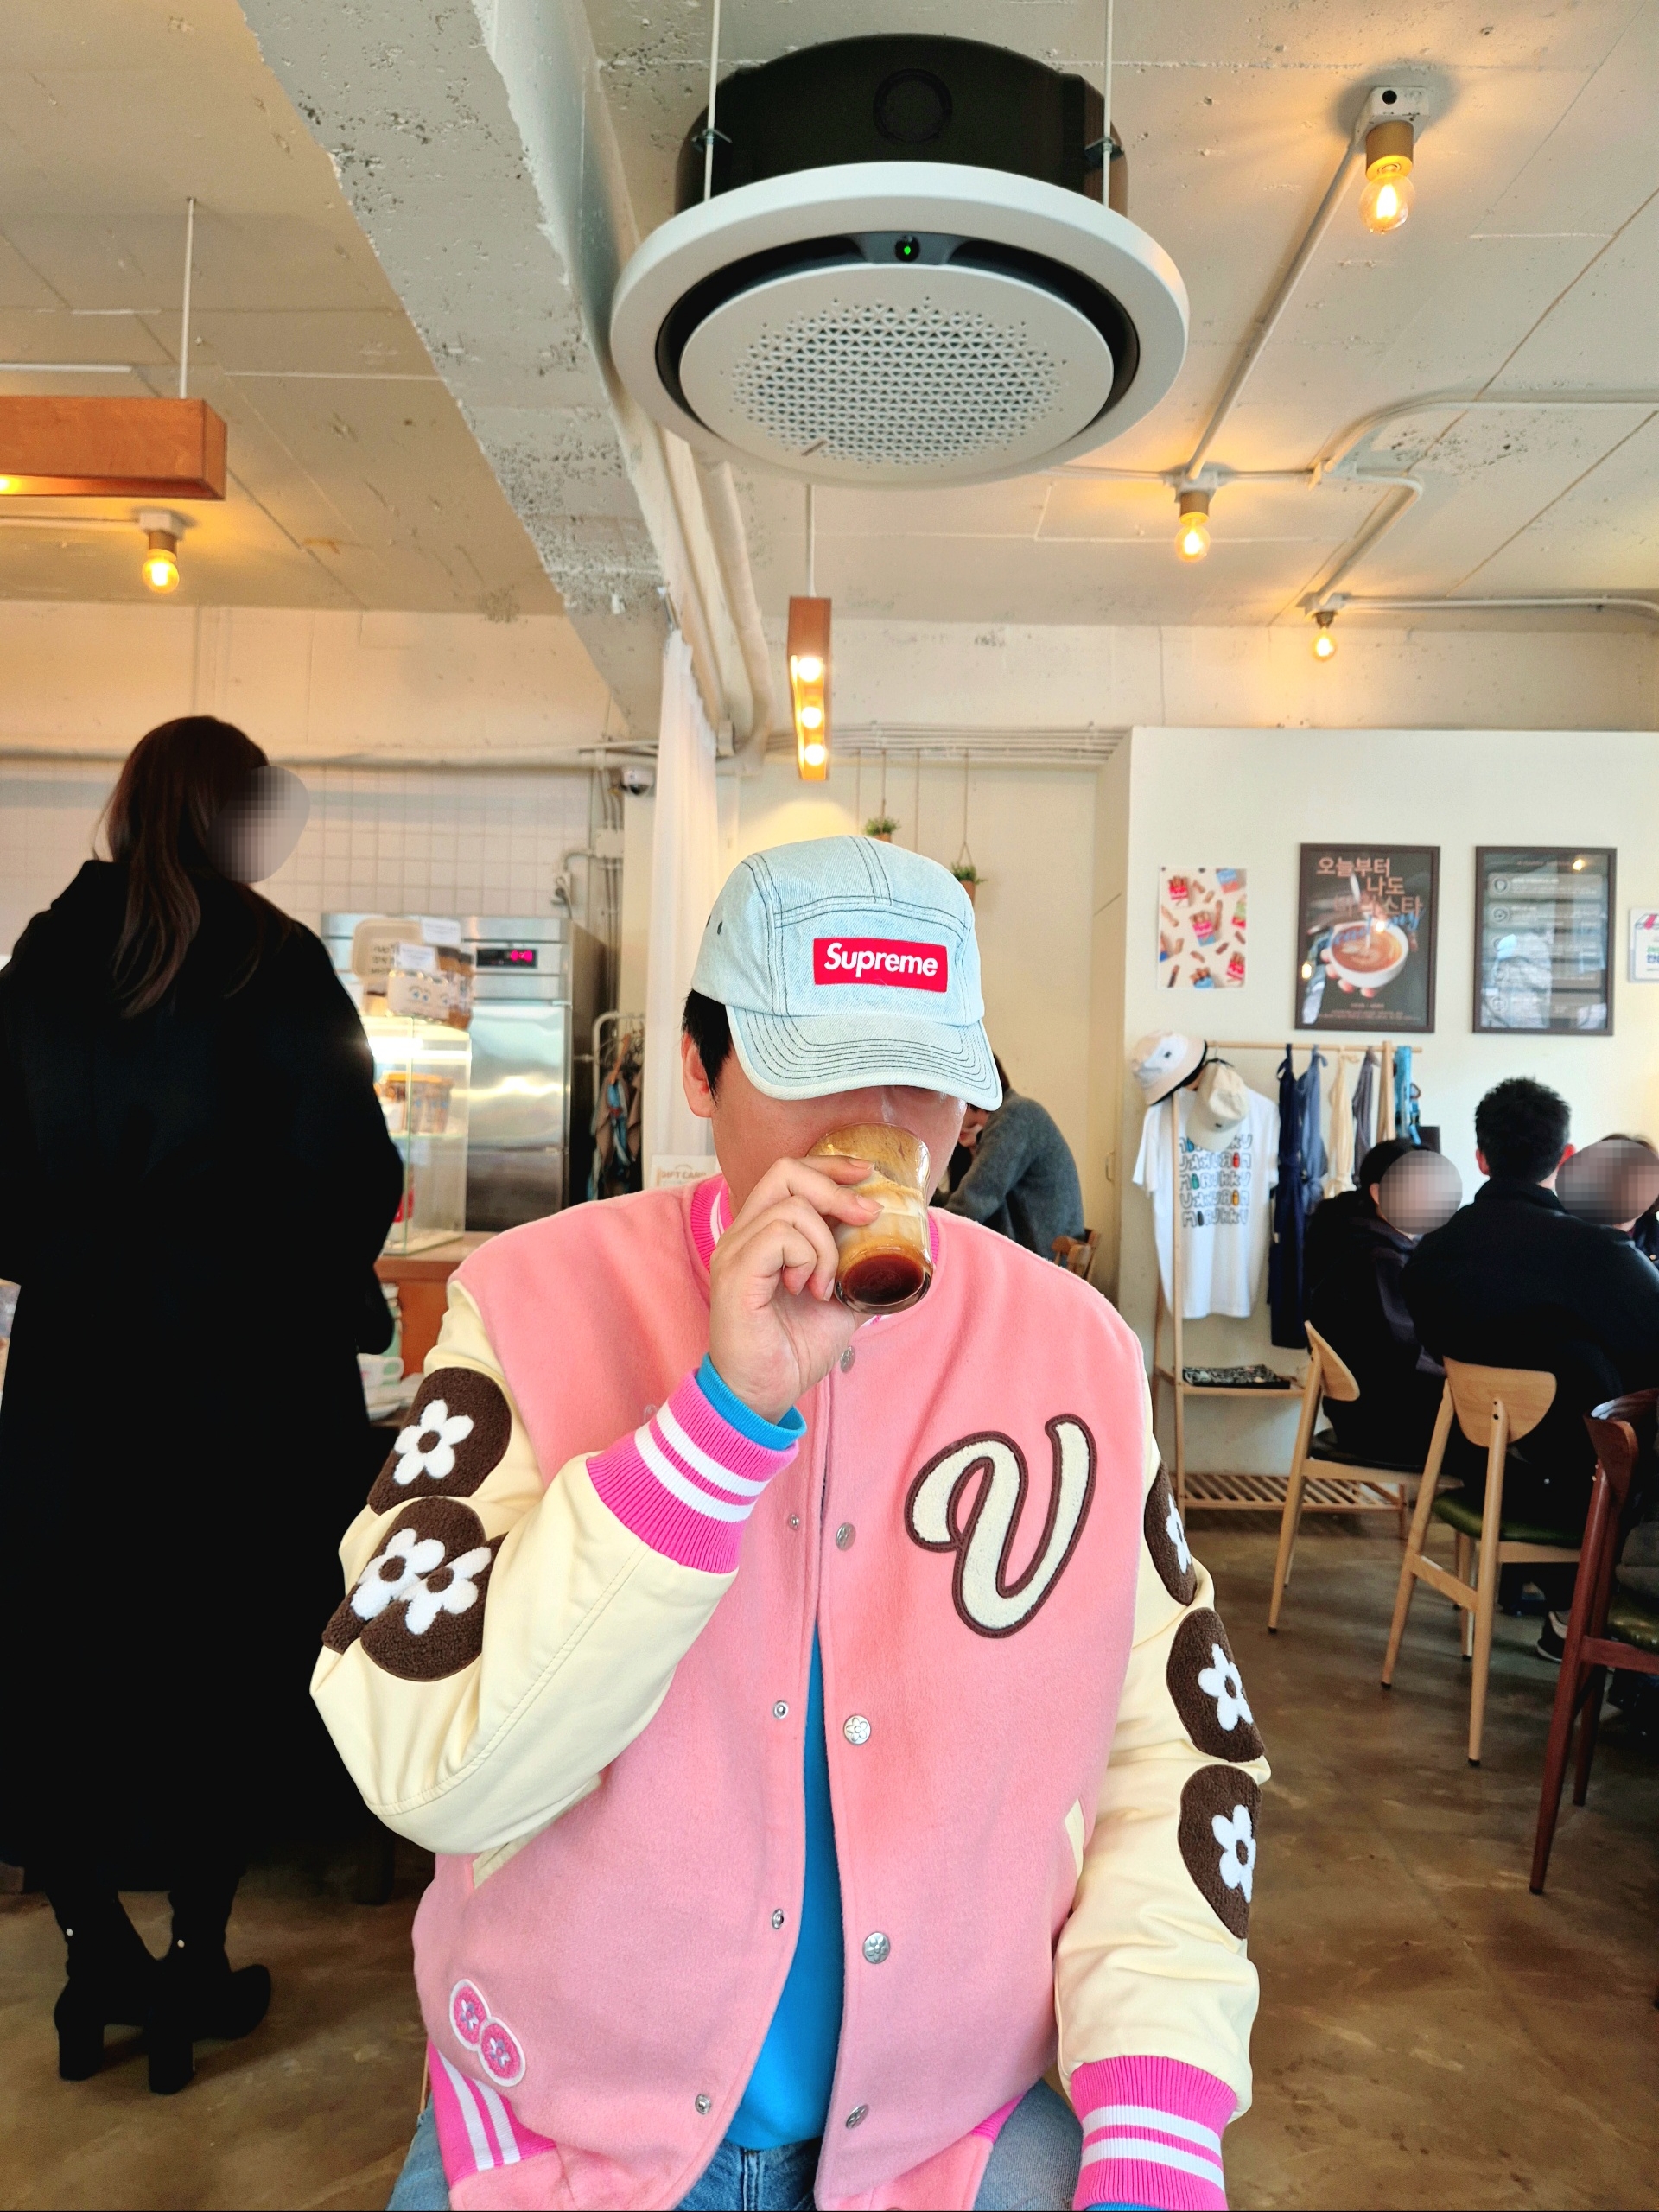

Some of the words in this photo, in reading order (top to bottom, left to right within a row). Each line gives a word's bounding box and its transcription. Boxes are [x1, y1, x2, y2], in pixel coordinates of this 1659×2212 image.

[1316, 856, 1391, 878] 오늘부터
[1366, 876, 1406, 898] 나도
[823, 942, 938, 978] Supreme
